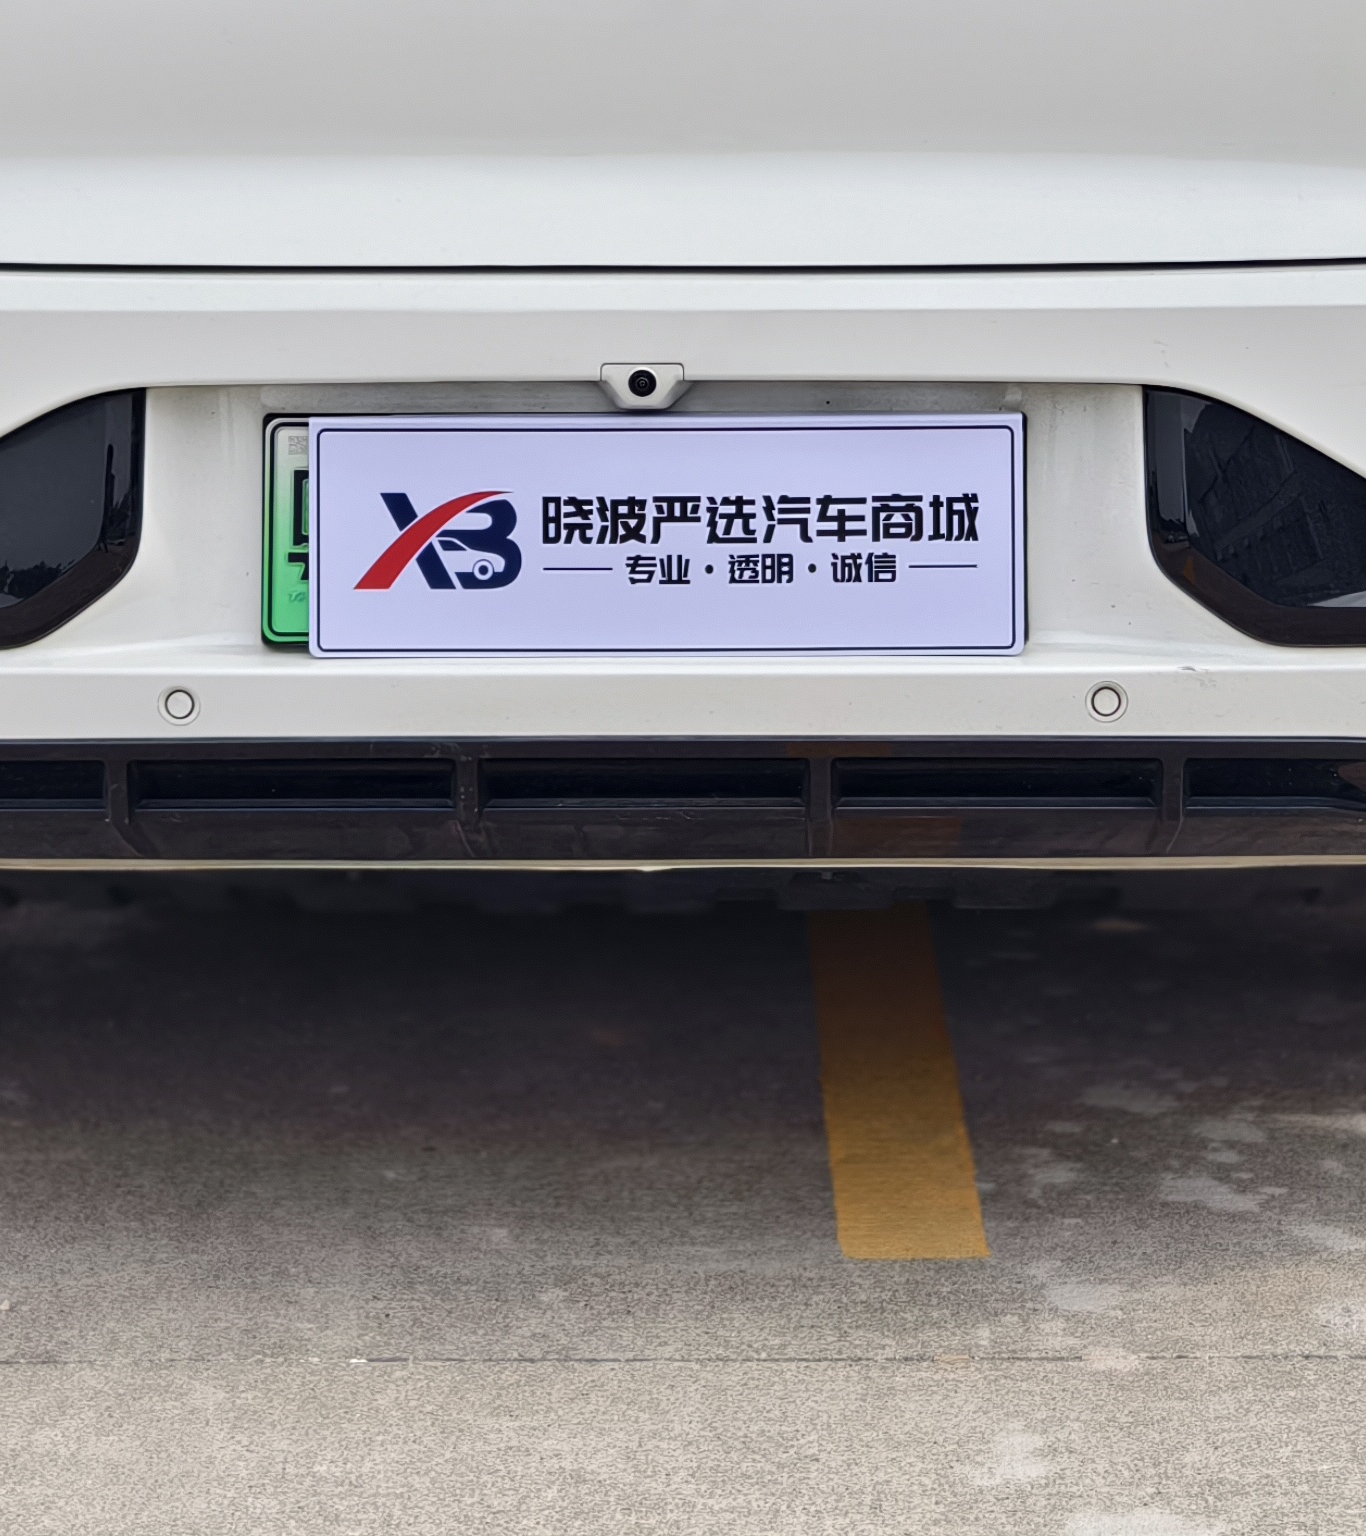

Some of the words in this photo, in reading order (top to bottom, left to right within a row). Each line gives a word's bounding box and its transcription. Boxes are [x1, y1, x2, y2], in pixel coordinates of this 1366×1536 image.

[541, 493, 979, 545] 晓波严选汽车商城
